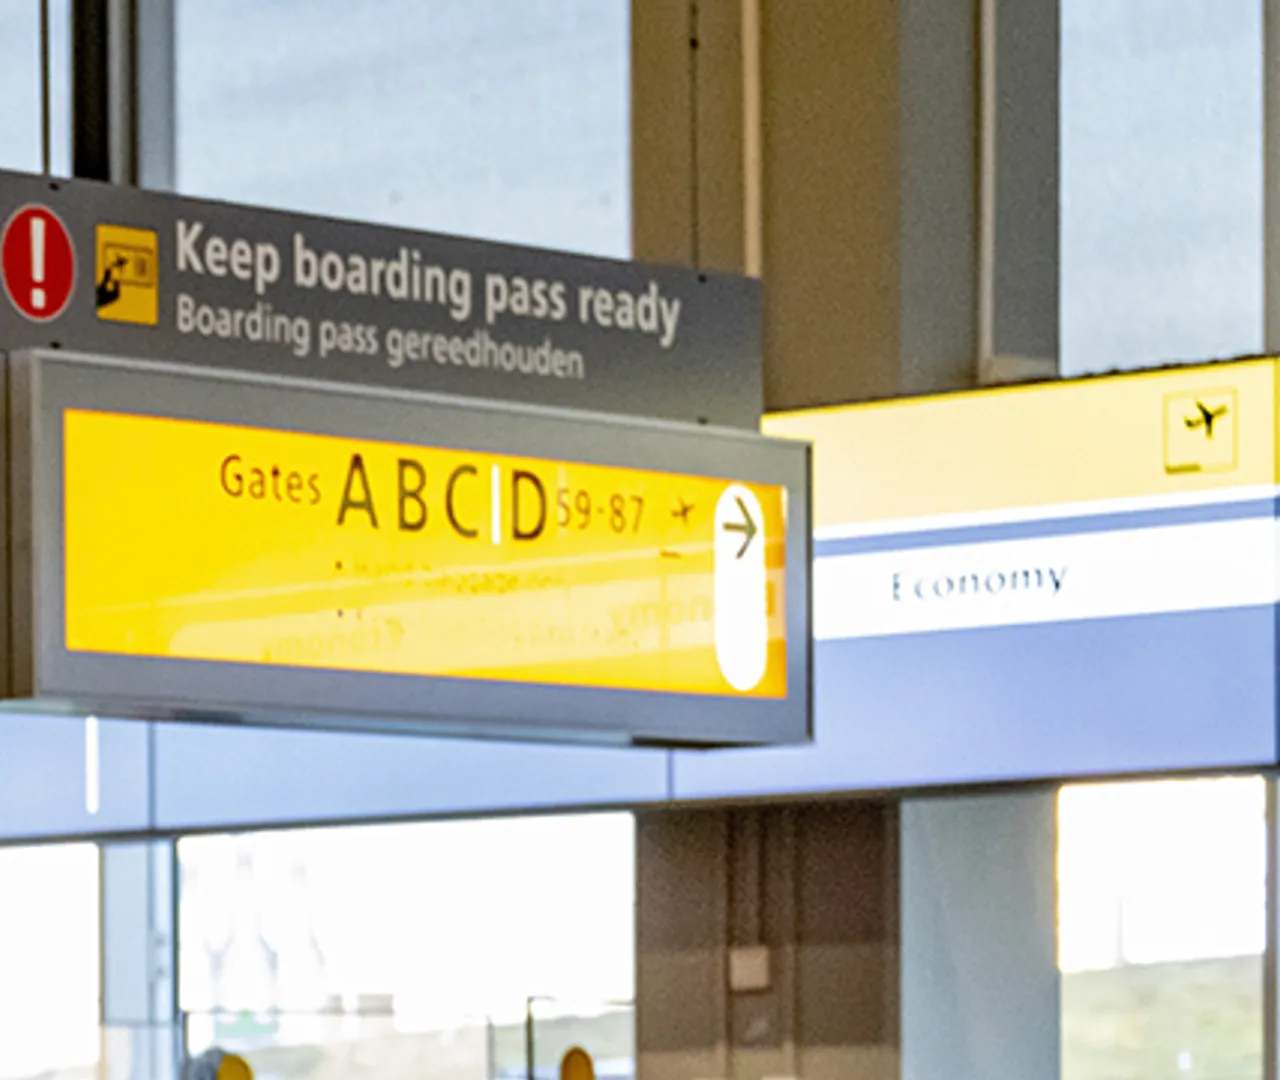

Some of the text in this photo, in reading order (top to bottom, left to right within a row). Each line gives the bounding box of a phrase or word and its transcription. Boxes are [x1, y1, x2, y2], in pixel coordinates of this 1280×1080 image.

[176, 218, 682, 349] Keep boarding pass ready
[176, 293, 585, 380] Boarding pass gereedhouden
[220, 453, 322, 506] Gates
[510, 468, 548, 542] D
[556, 487, 645, 535] 59-87
[892, 564, 1069, 602] Economy
